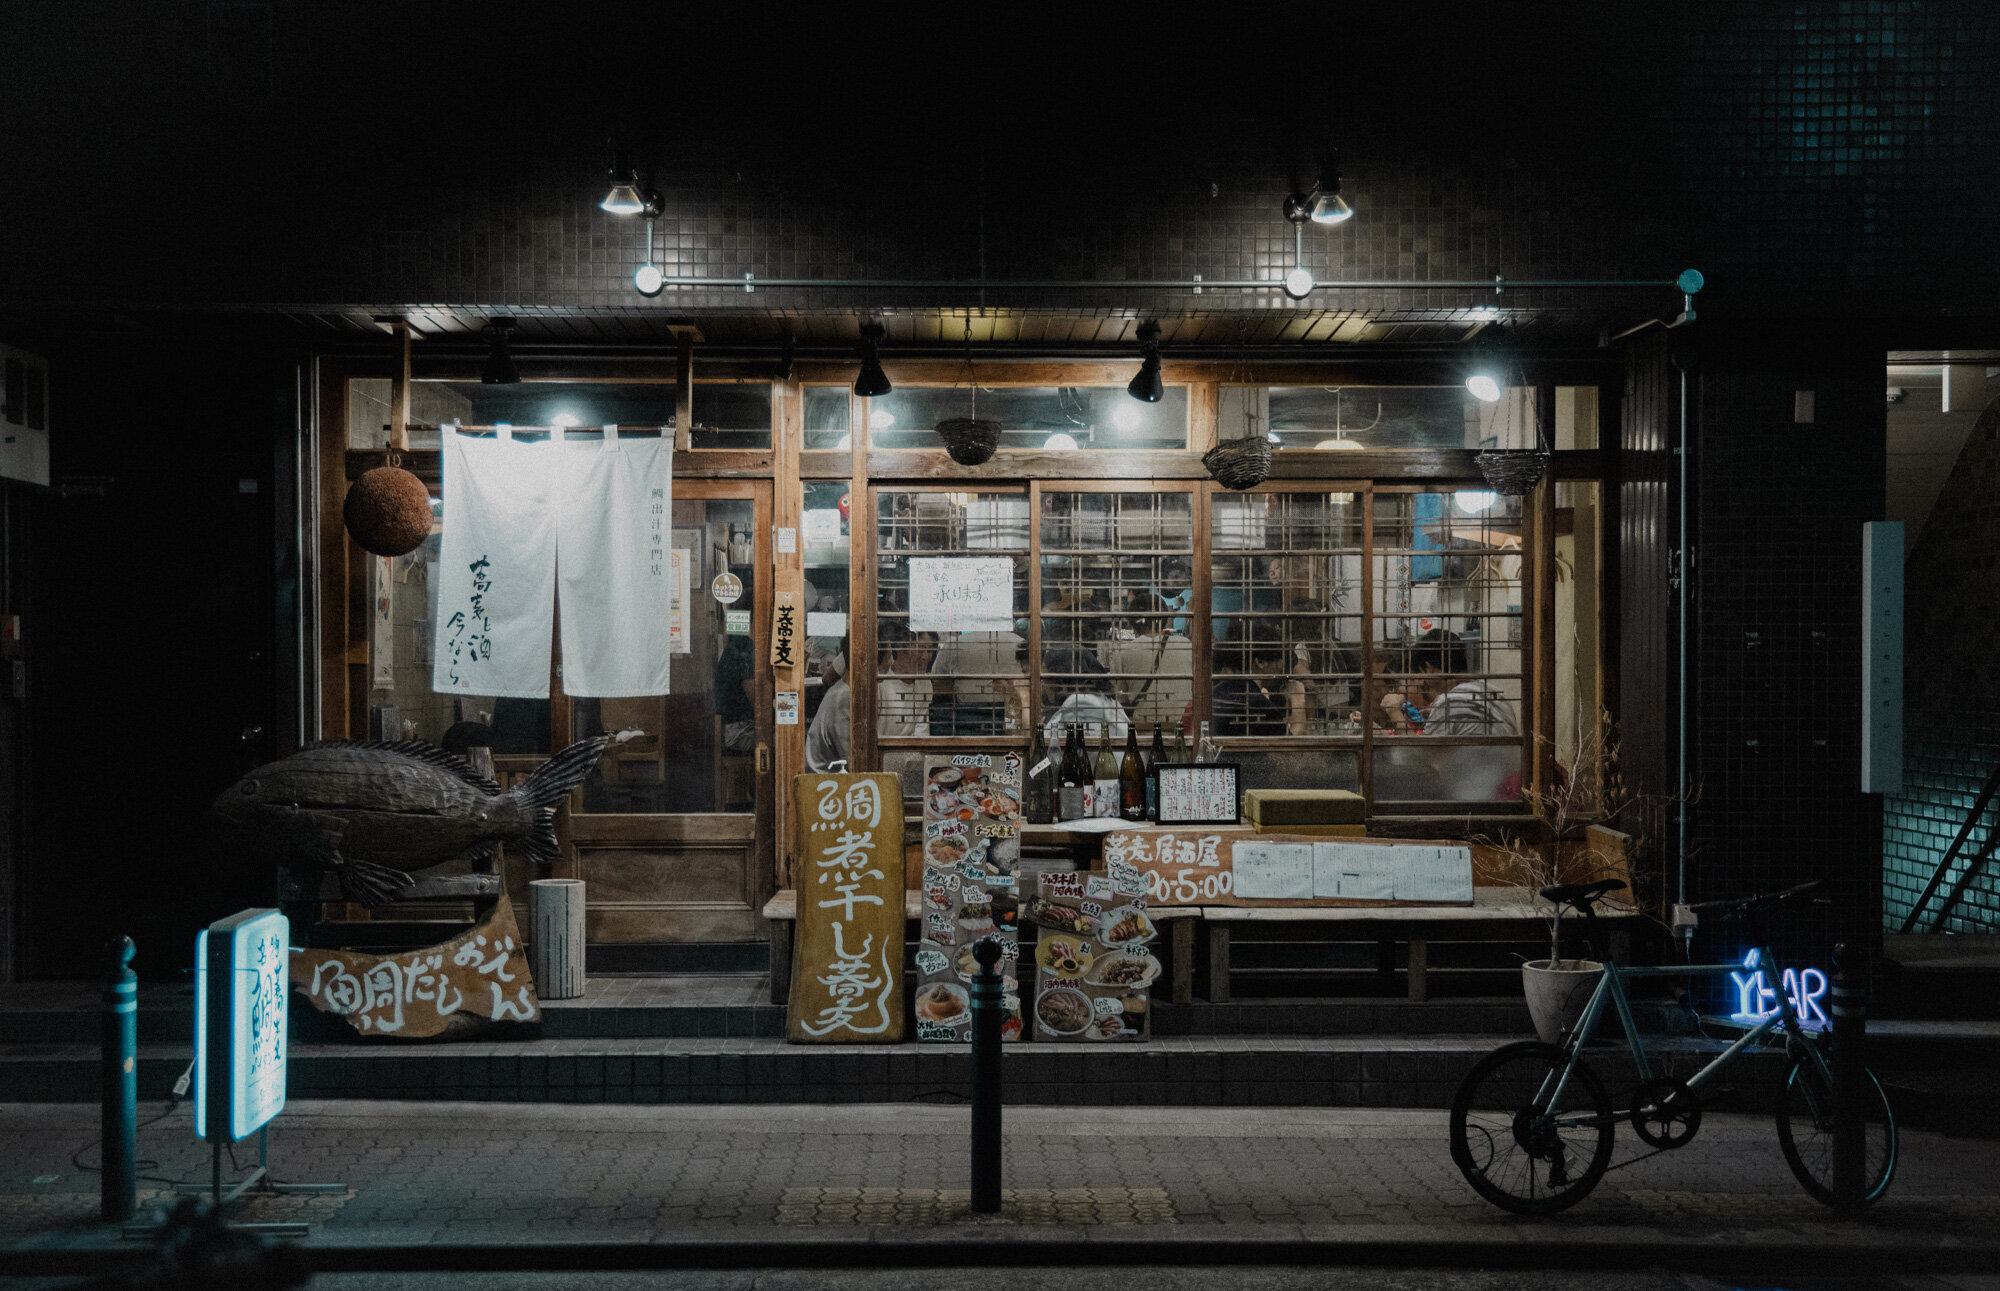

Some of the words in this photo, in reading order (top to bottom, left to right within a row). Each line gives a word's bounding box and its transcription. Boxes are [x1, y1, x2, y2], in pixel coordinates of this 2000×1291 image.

[650, 487, 664, 576] 鯛出汁専門店
[447, 612, 465, 685] 今なら
[468, 555, 492, 661] 蕎麦と酒
[774, 605, 794, 666] 蕎麦
[801, 779, 894, 1036] 鯛煮干し蕎麦
[1082, 903, 1101, 915] たたき
[454, 935, 536, 1022] おでん
